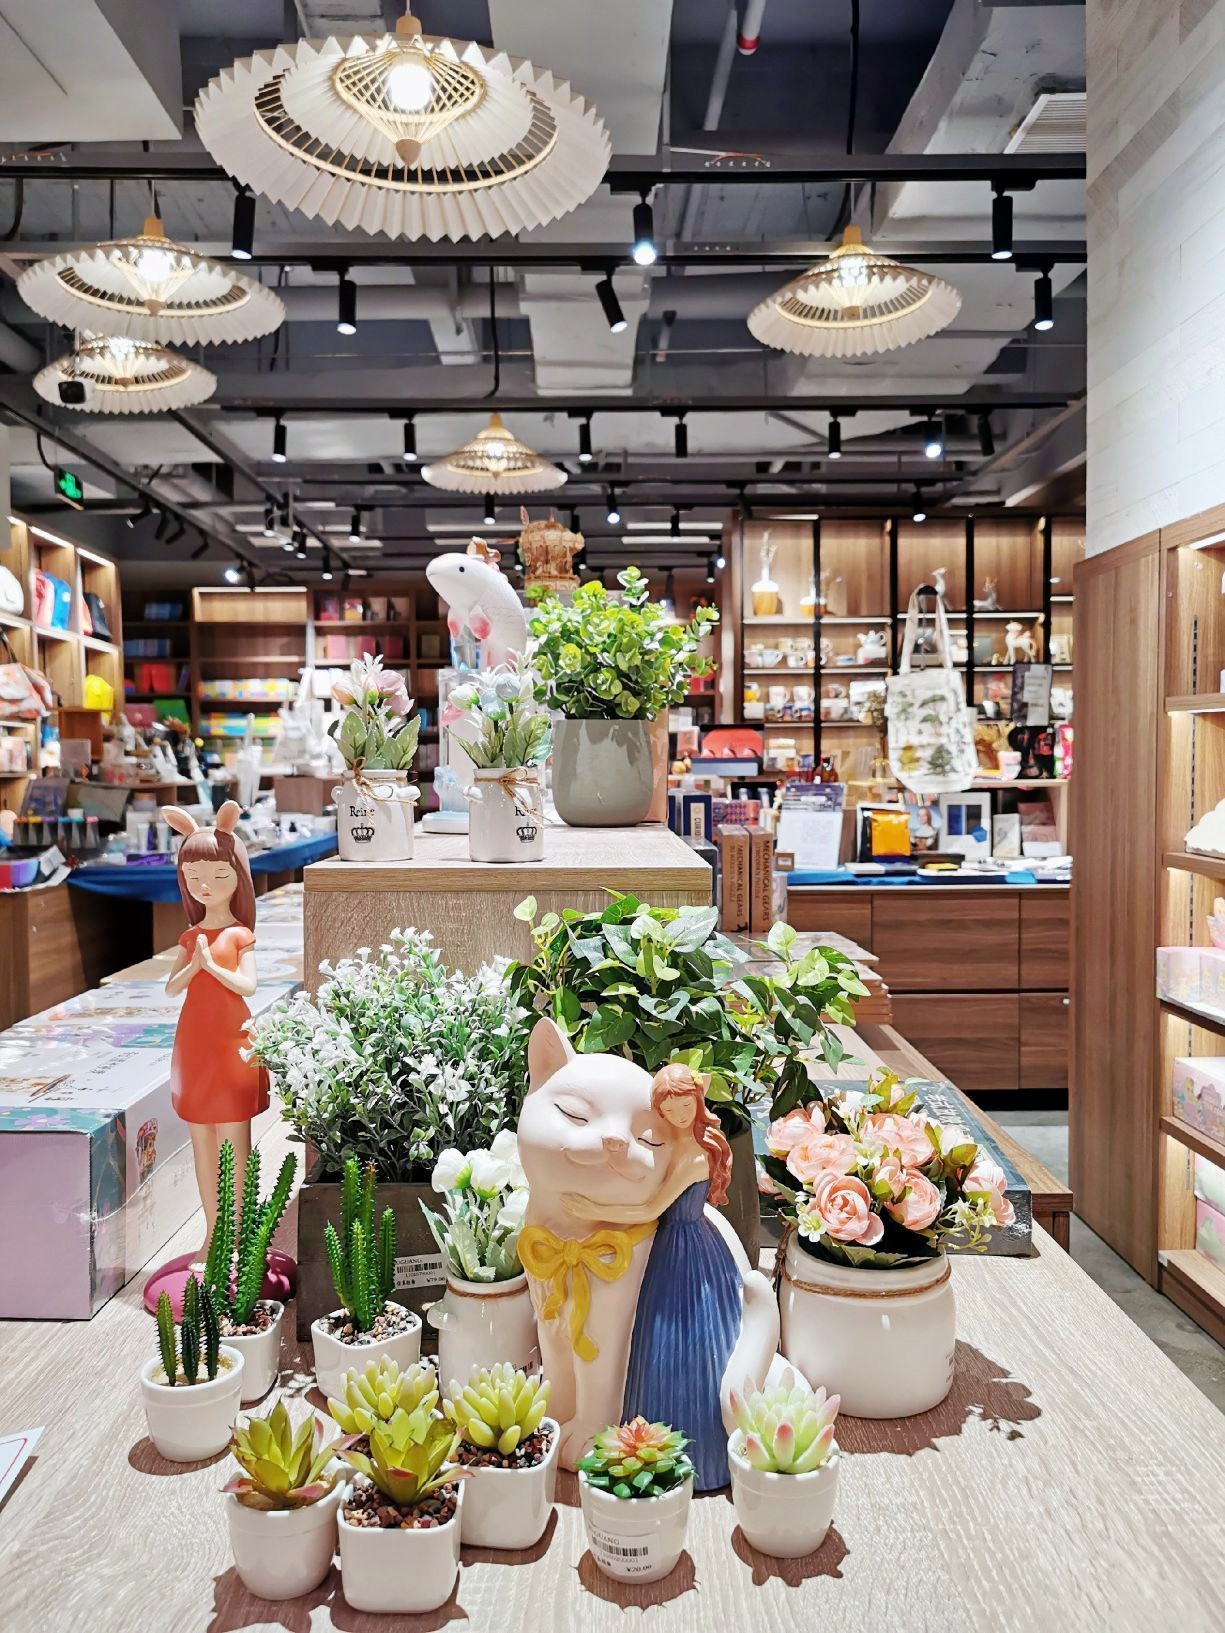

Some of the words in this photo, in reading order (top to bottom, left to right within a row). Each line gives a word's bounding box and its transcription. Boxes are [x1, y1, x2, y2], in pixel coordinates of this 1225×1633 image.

[736, 844, 744, 892] MECHANICAL
[762, 840, 770, 893] MECHANICAL
[736, 893, 744, 918] GEARS
[761, 894, 770, 922] GEARS
